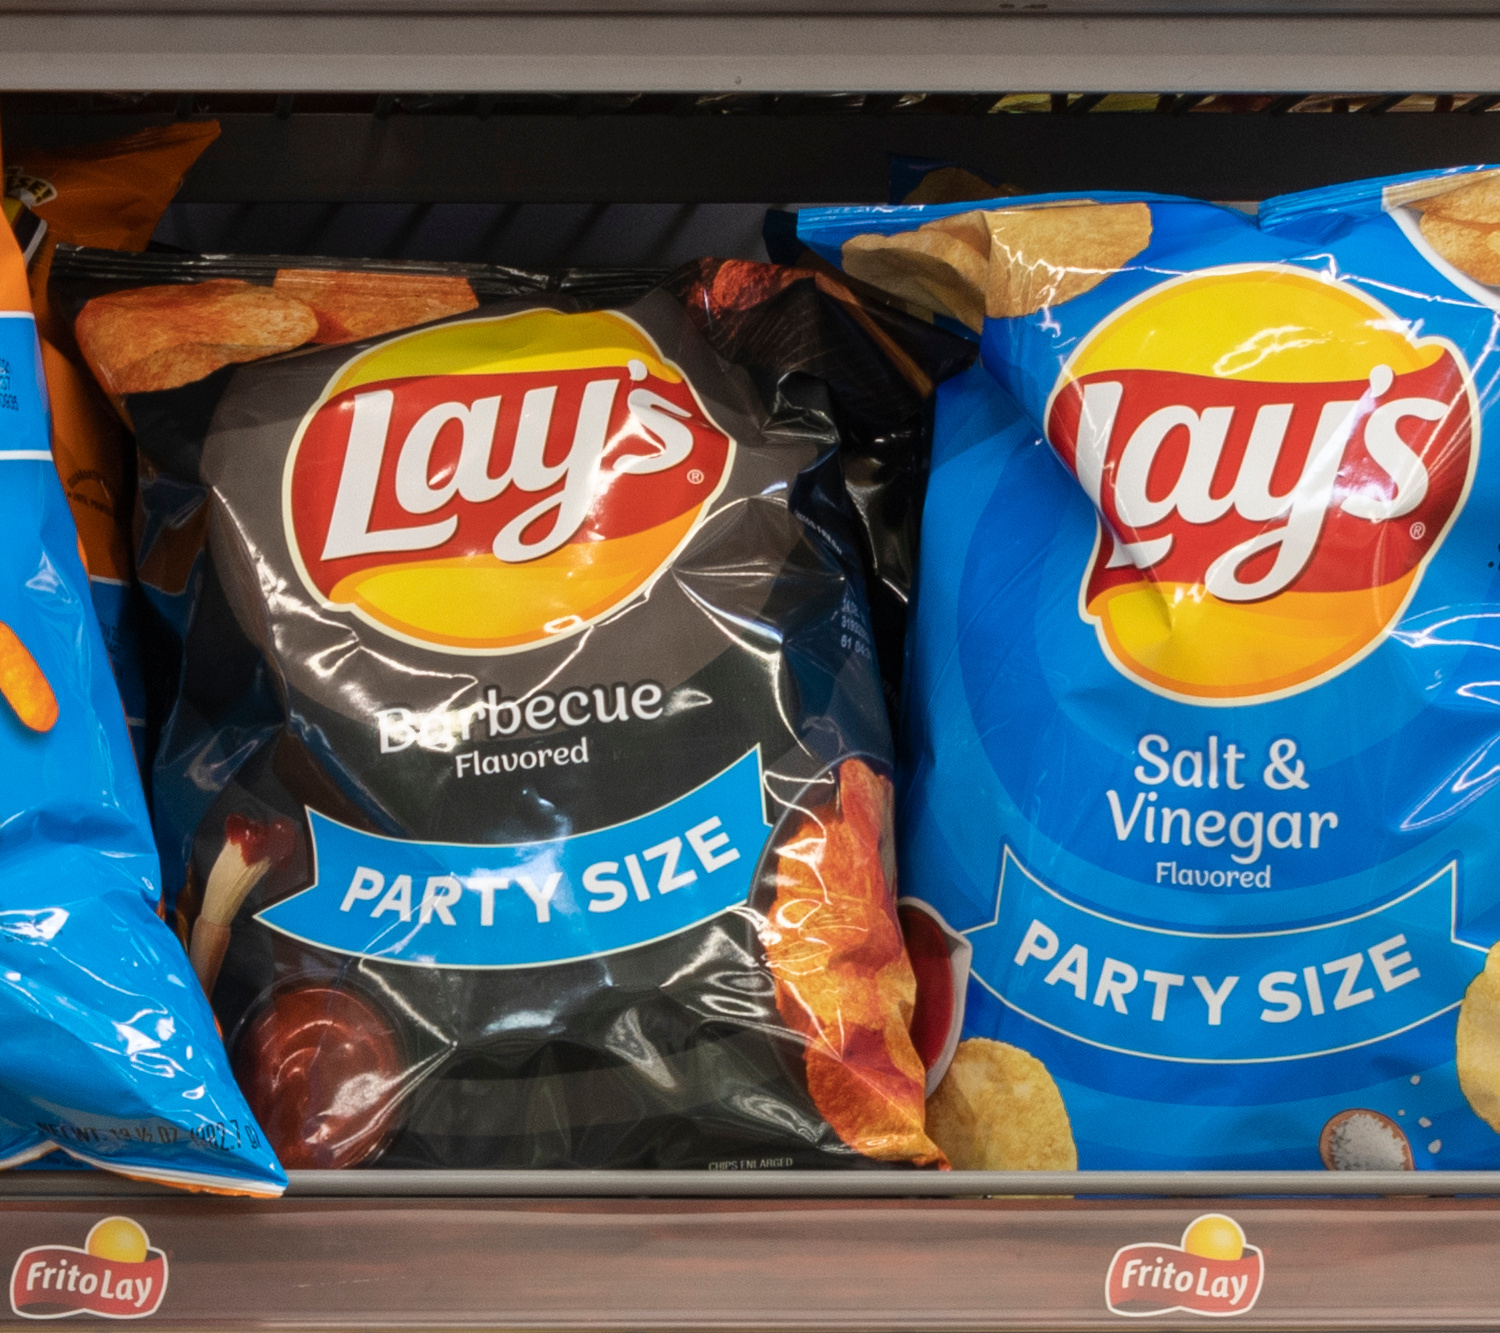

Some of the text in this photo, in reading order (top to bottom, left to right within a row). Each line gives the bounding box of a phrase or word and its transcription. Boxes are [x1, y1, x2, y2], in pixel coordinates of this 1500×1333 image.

[321, 358, 694, 562] Lay's
[1080, 366, 1448, 602] Lay's
[454, 736, 590, 779] Flavored
[1133, 733, 1311, 791] Salt &
[1105, 789, 1339, 864] Vinegar
[339, 815, 741, 926] PARTY SIZE
[1154, 860, 1272, 890] Flavored
[1013, 919, 1421, 1026] PARTY SIZE
[741, 1158, 794, 1169] ENLARGED
